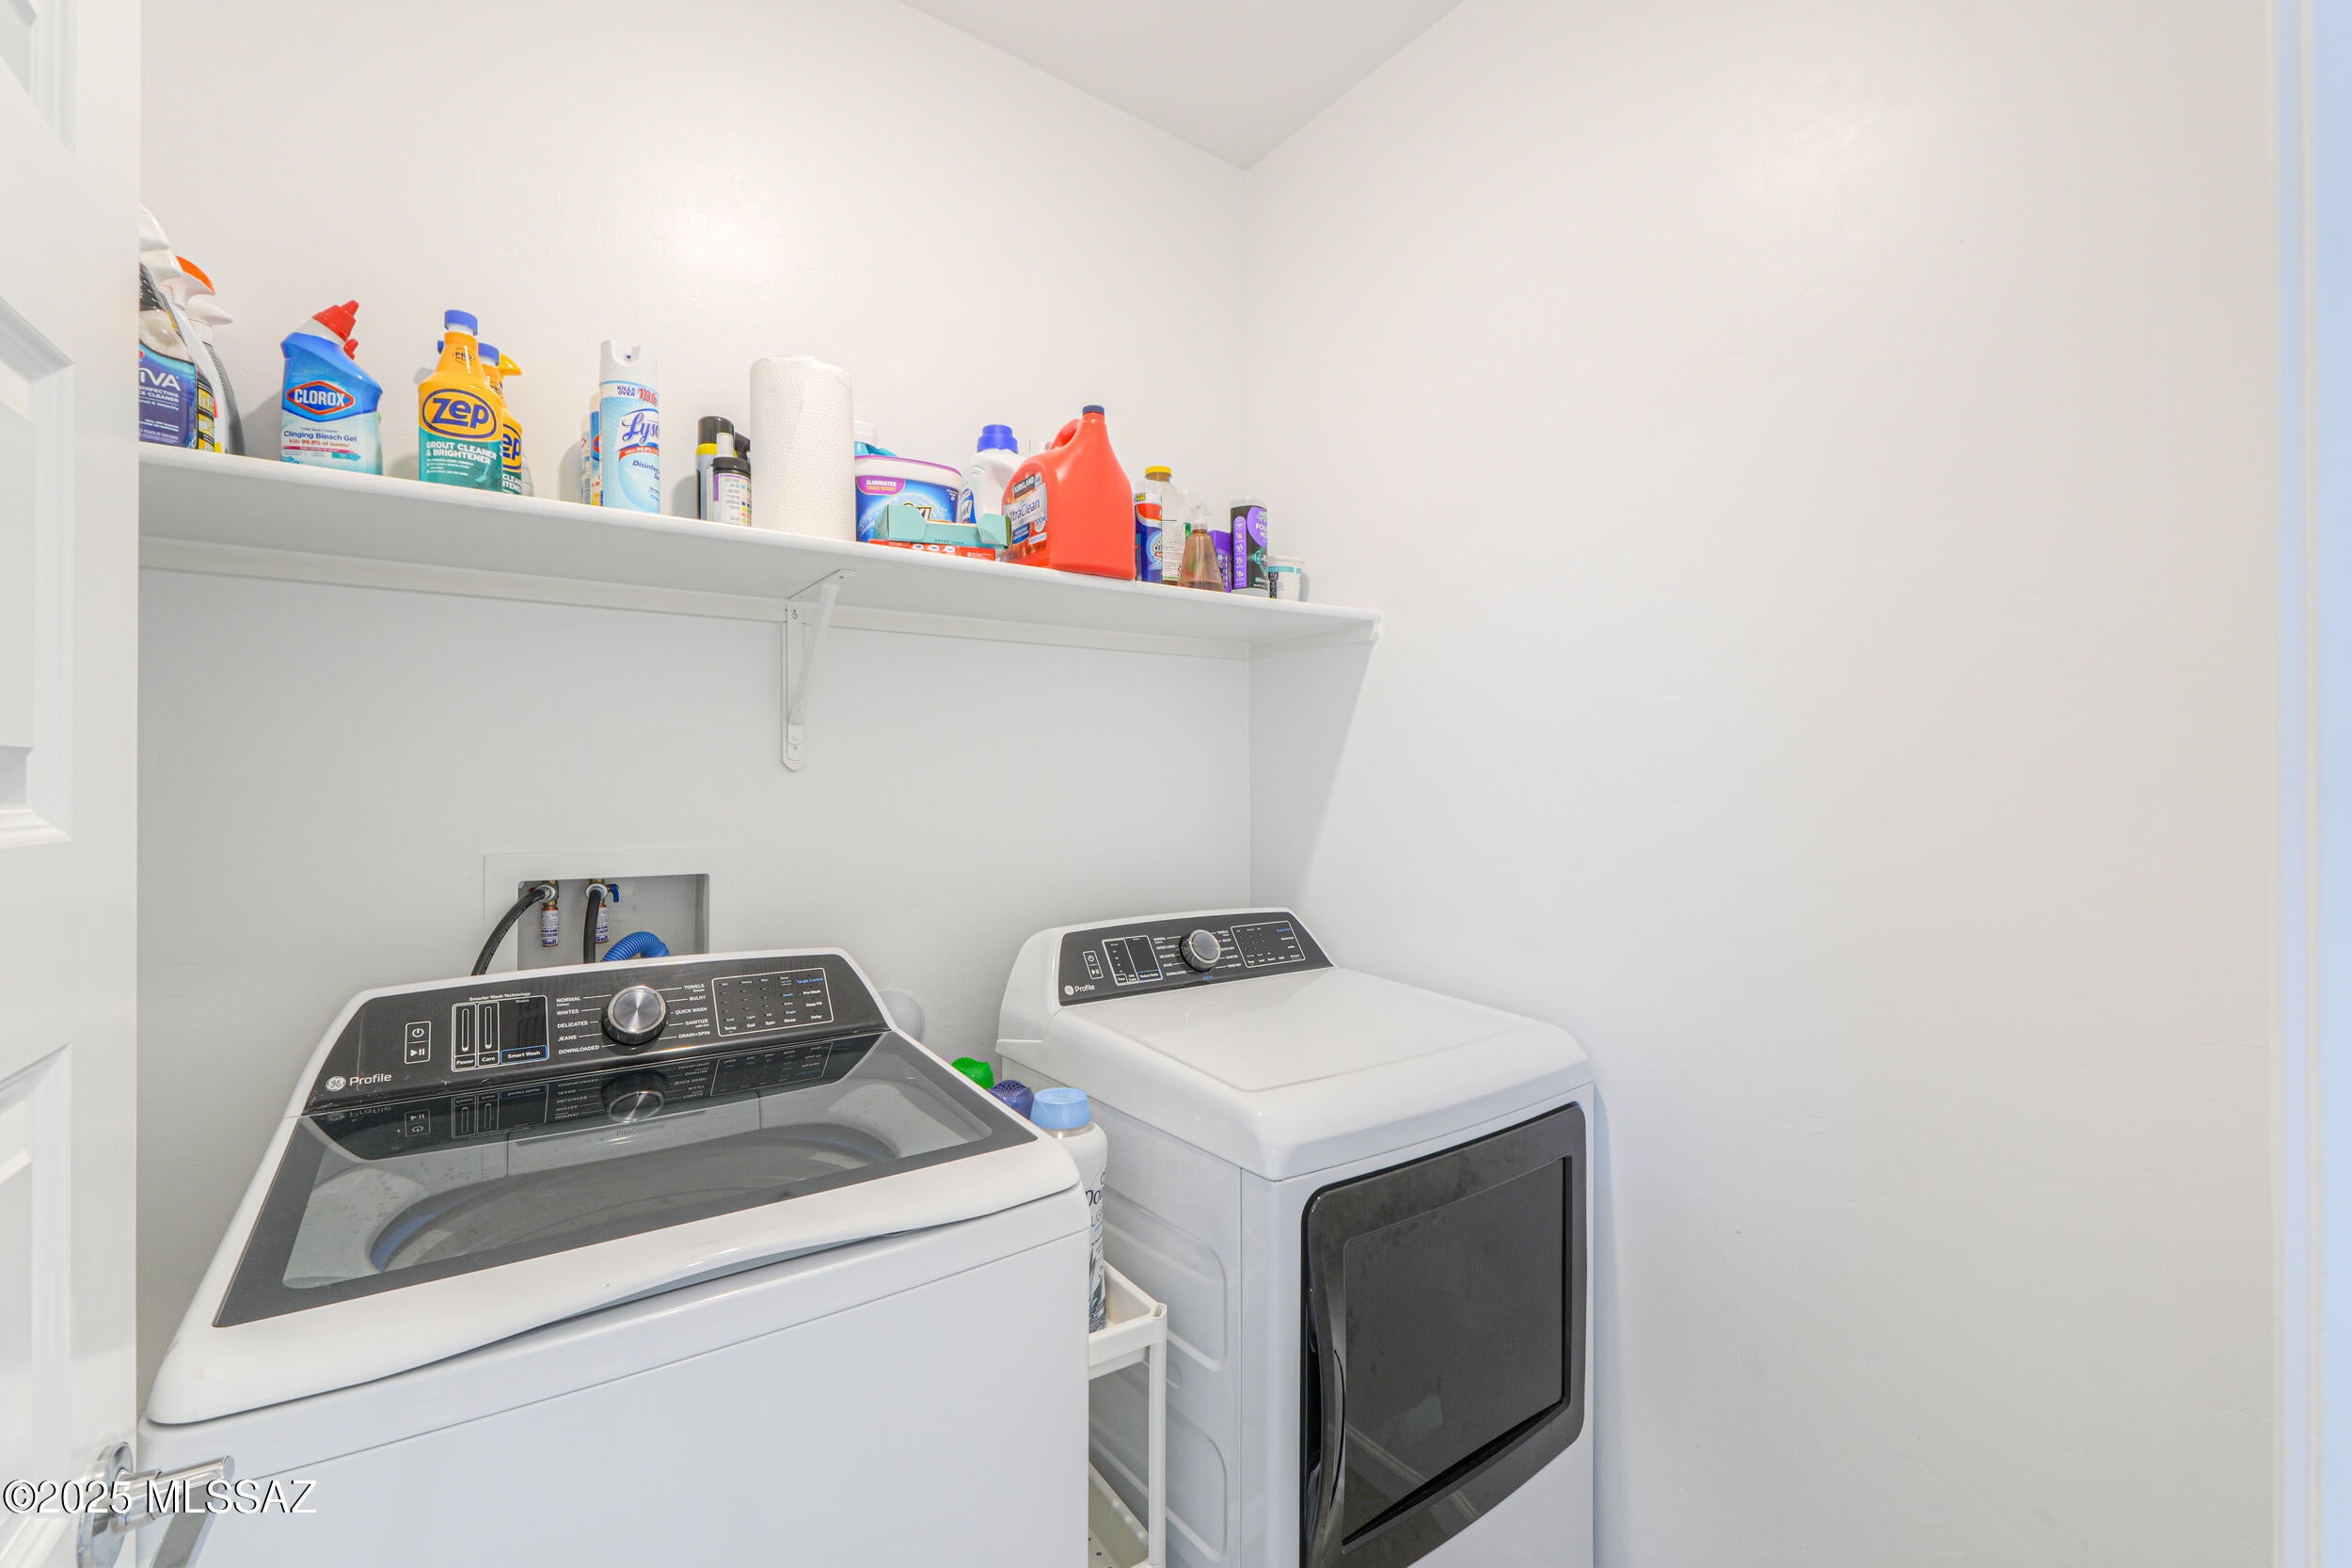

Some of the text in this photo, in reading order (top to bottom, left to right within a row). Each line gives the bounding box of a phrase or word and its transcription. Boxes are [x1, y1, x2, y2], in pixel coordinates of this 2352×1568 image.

[294, 388, 345, 407] CLOROX
[432, 397, 489, 429] Zep
[283, 431, 313, 439] Clinging
[316, 432, 342, 440] Bleach
[426, 441, 497, 460] GROUT CLEANER
[433, 450, 491, 465] BRIGHTENER
[1014, 475, 1035, 493] KIRKLAND
[1074, 984, 1095, 992] Profile
[558, 1045, 599, 1054] DOWNLOADED
[349, 1072, 392, 1086] Profile
